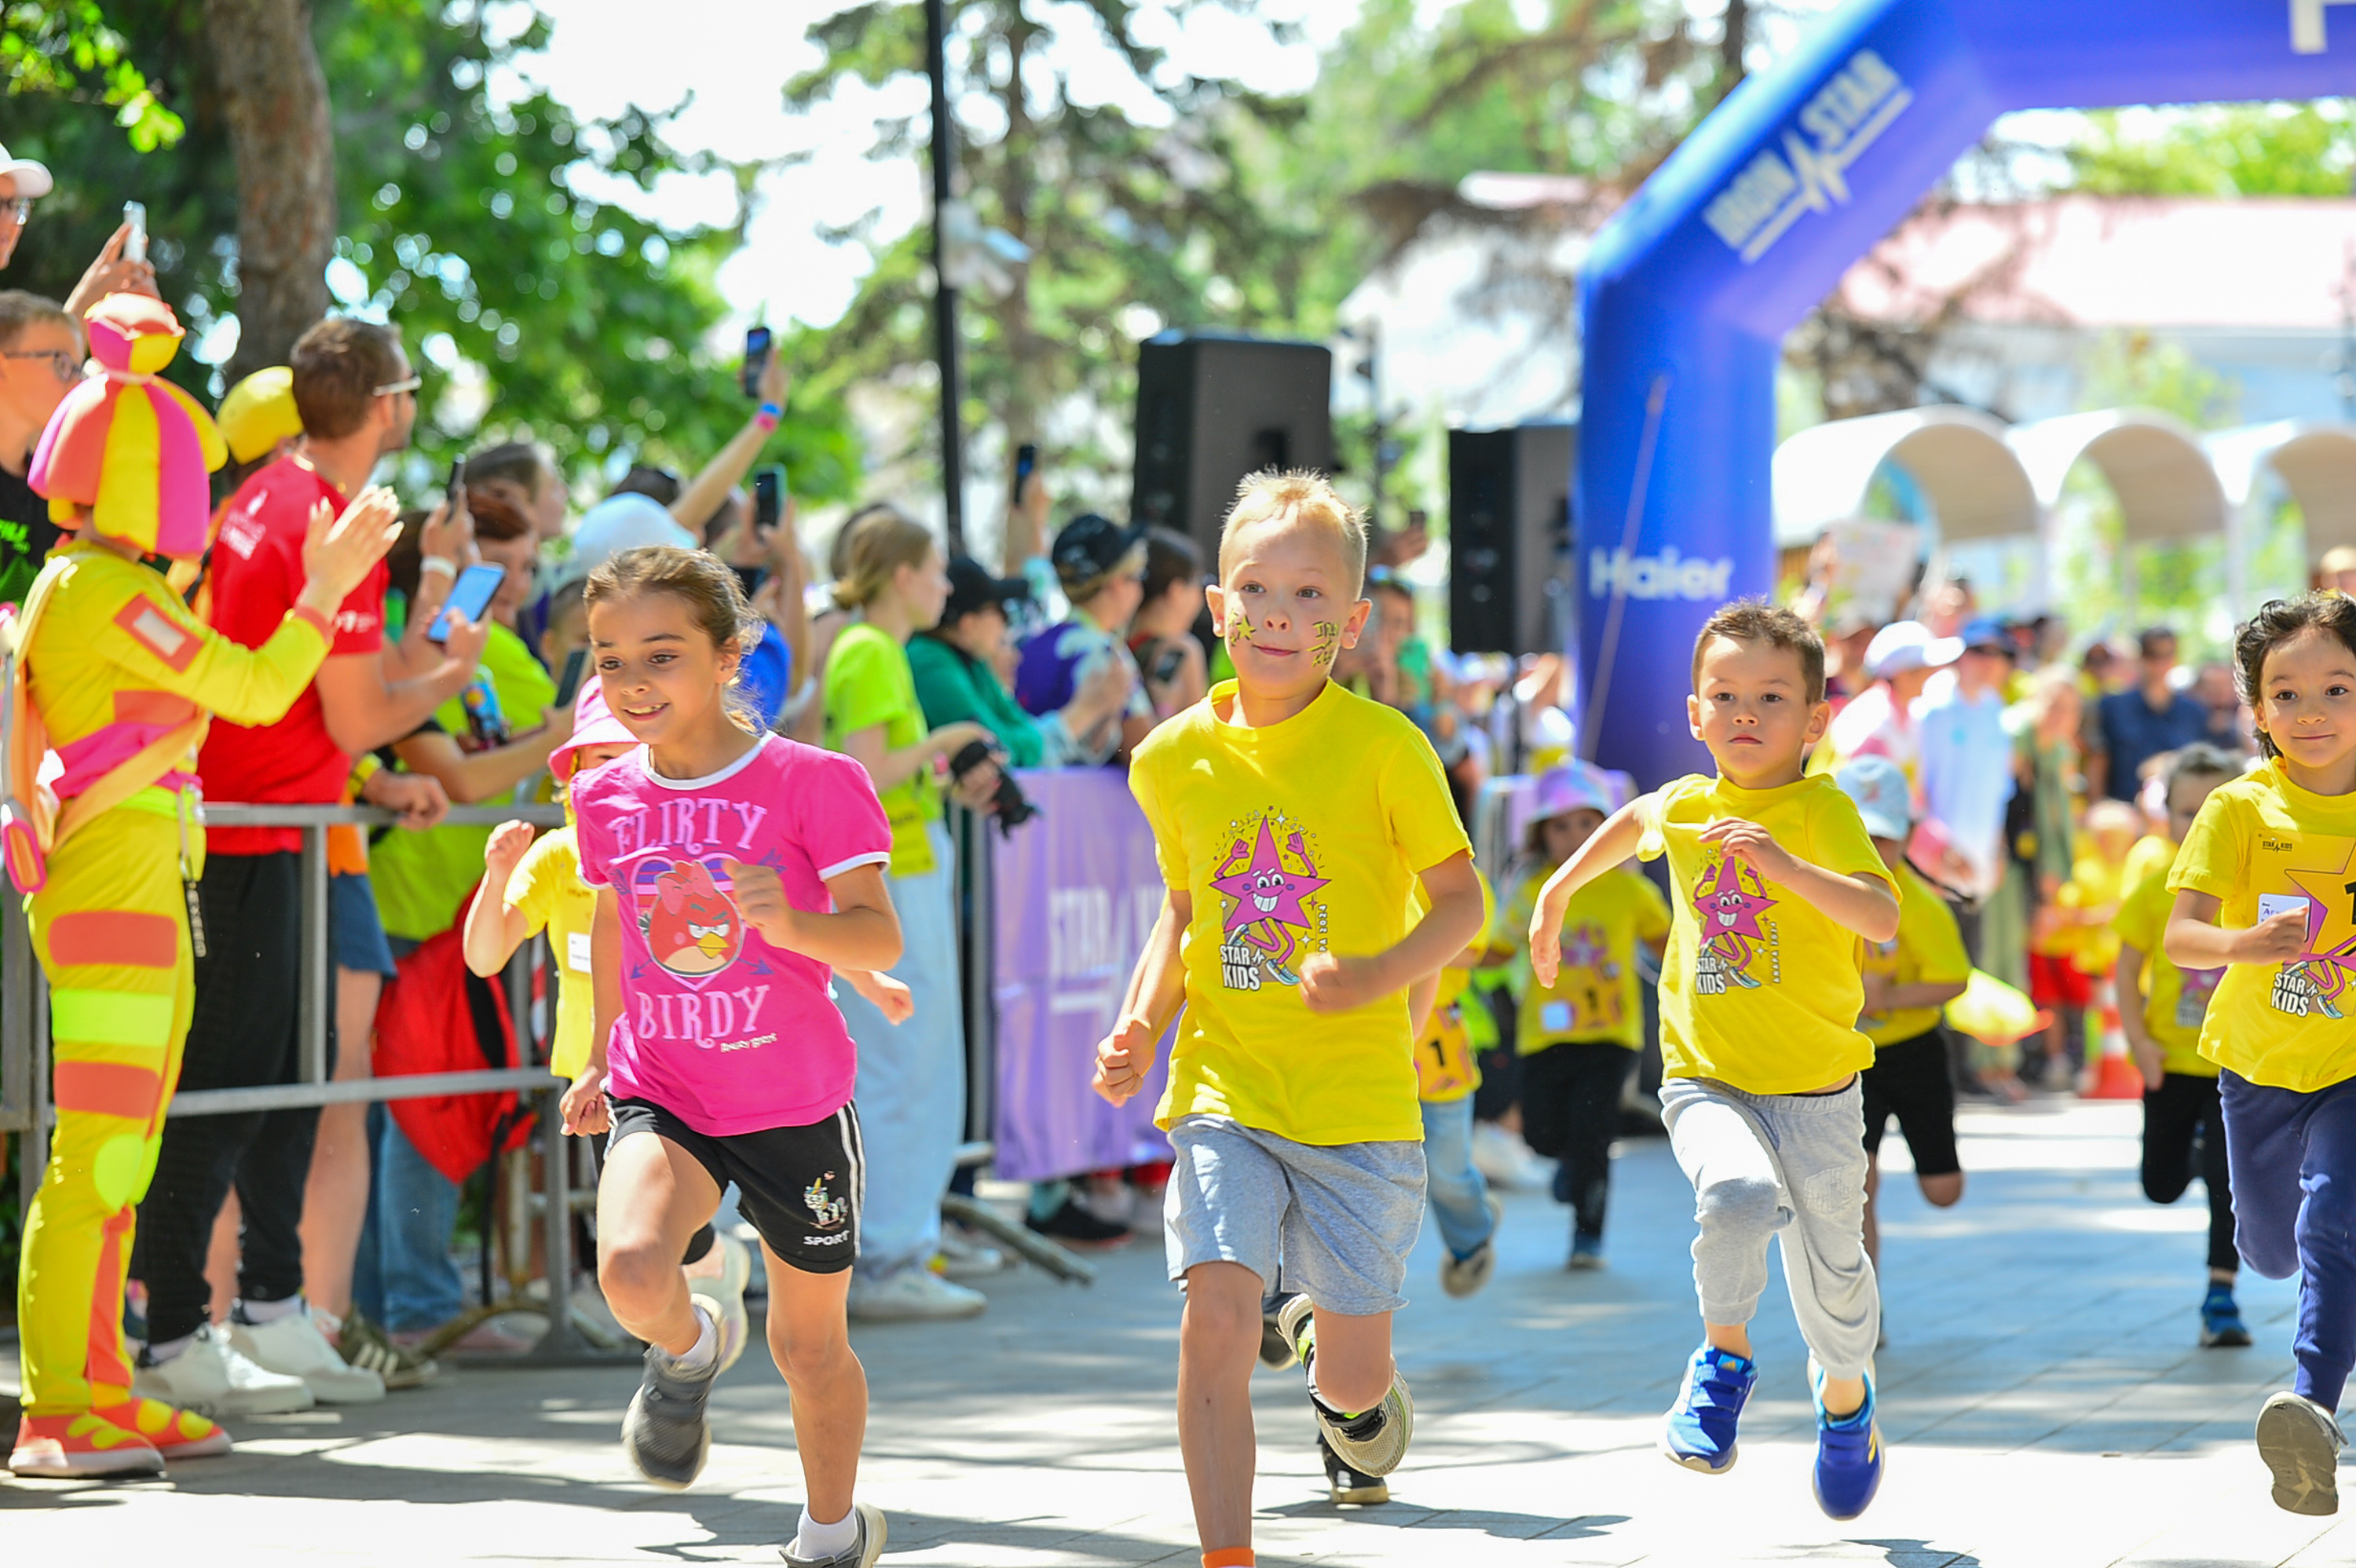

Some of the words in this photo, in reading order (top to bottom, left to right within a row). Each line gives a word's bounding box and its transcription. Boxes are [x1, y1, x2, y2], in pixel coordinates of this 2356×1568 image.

[1798, 47, 1902, 152] STAR
[1589, 544, 1735, 601] Haier
[607, 798, 768, 856] FLIRTY
[1318, 904, 1328, 934] 2024
[1769, 921, 1780, 947] 2024
[1220, 945, 1250, 965] STAR
[1696, 956, 1718, 974] STAR
[1222, 963, 1260, 991] KIDS
[1696, 973, 1726, 995] KIDS
[2274, 972, 2307, 995] STAR
[635, 984, 770, 1049] BIRDY
[2270, 988, 2309, 1018] KIDS
[1429, 1040, 1445, 1067] 1
[803, 1230, 850, 1246] SPORT
